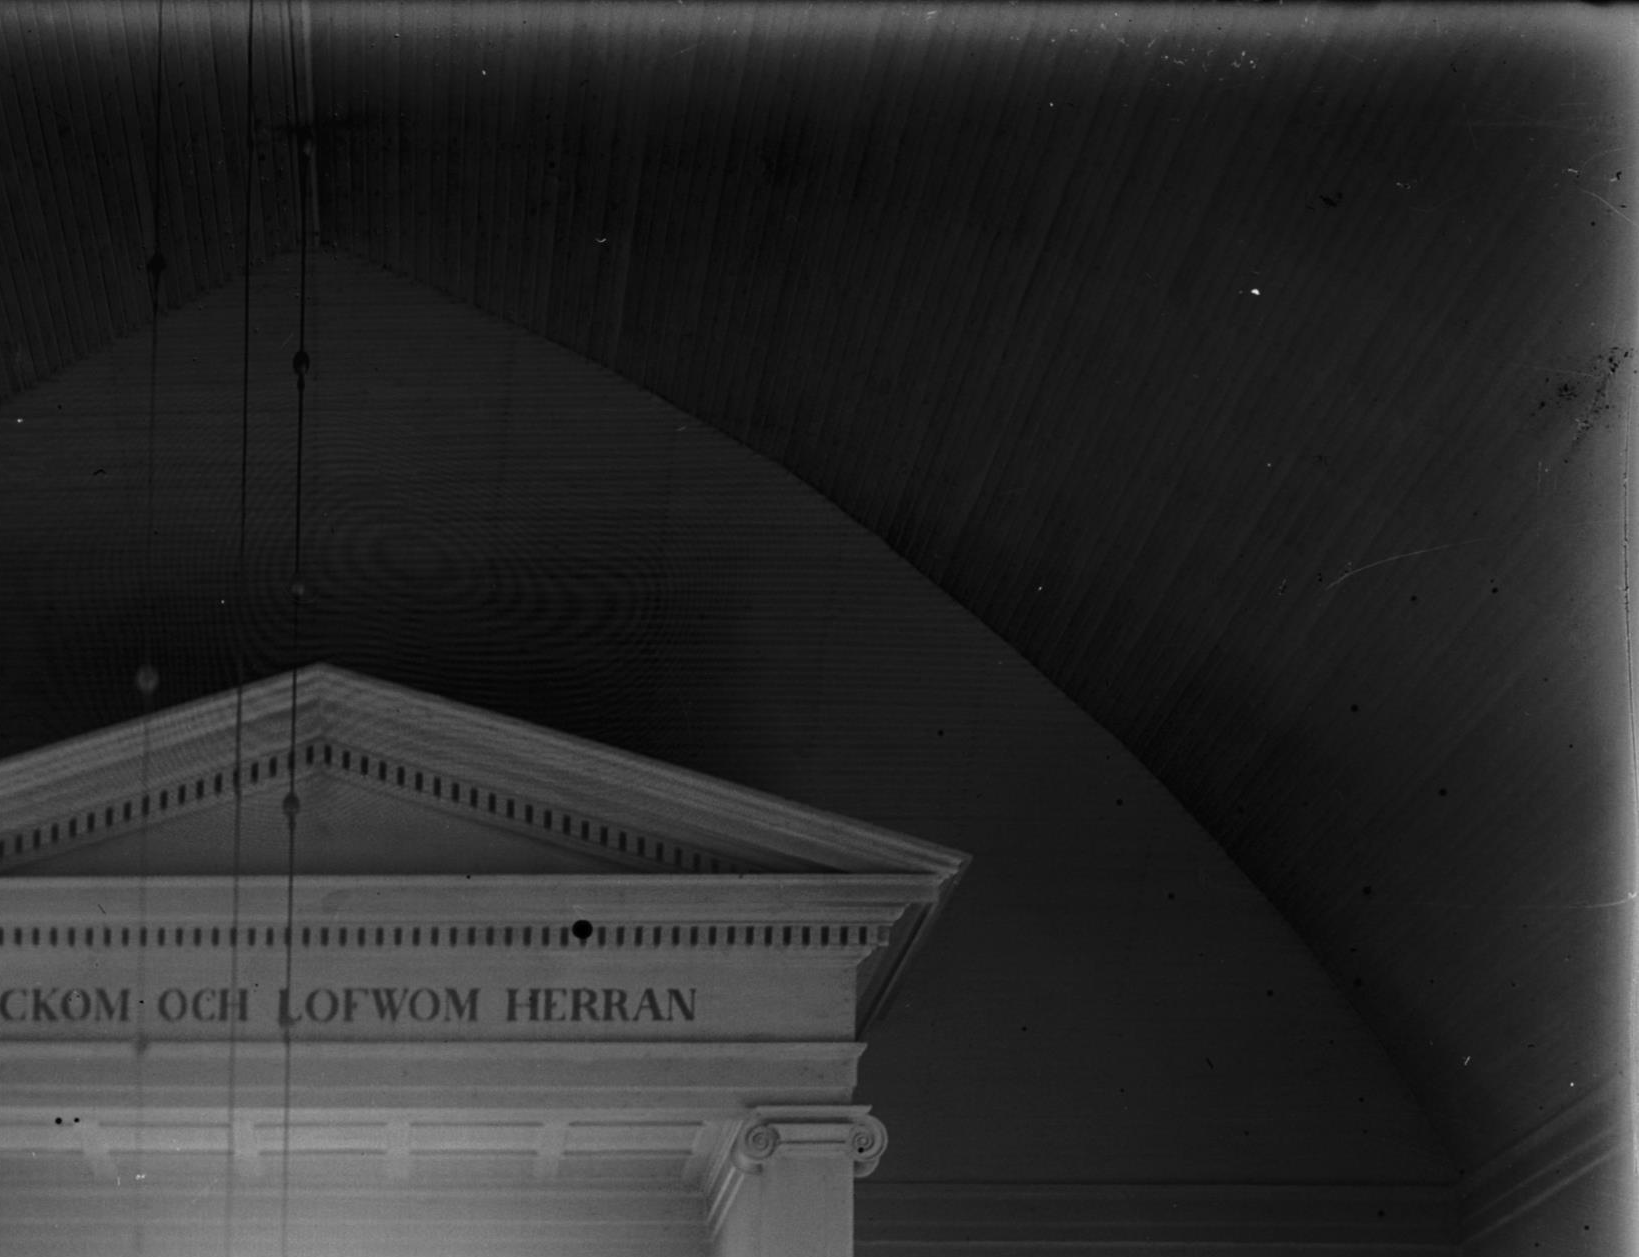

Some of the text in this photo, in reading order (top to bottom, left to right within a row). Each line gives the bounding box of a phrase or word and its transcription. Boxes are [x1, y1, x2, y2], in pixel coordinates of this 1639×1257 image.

[157, 986, 249, 1023] OCH
[277, 986, 479, 1024] LOFWOM
[506, 986, 697, 1023] HERRAN
